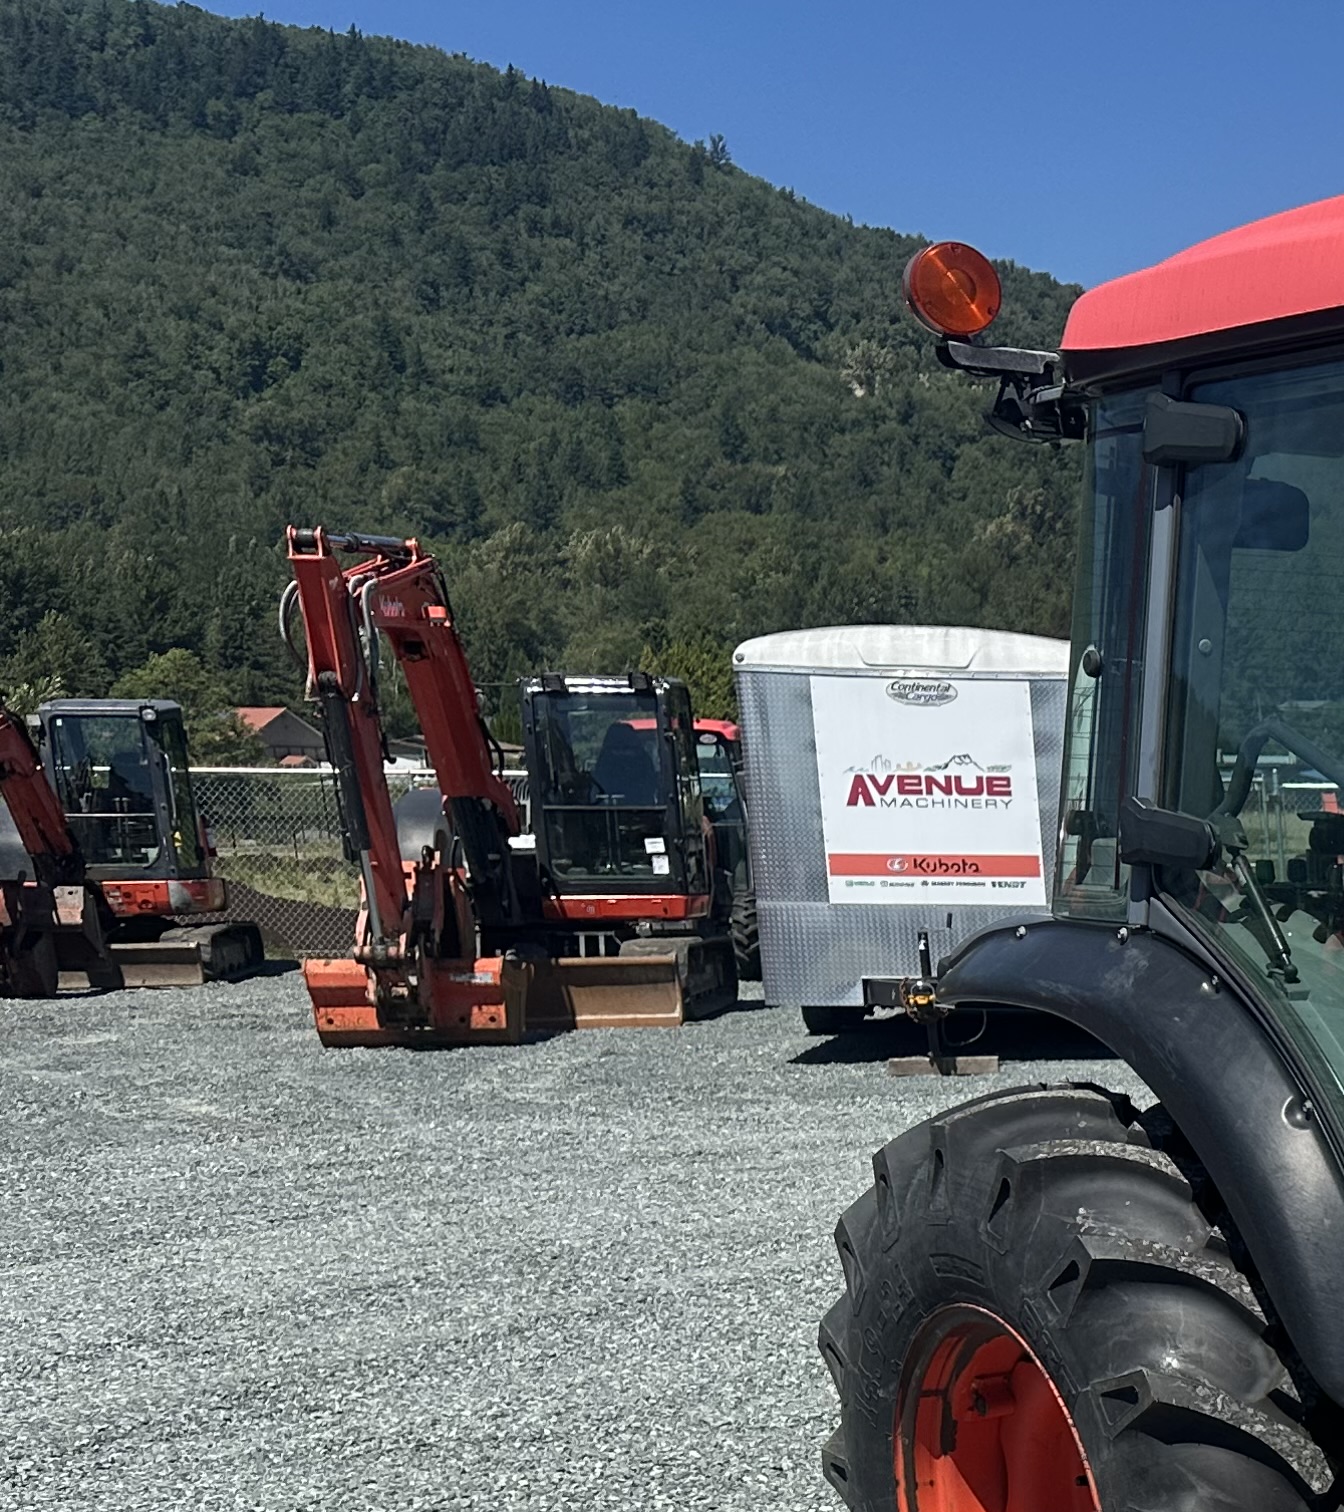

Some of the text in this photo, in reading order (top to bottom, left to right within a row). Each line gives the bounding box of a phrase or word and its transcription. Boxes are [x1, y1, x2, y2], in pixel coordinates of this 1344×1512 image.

[891, 681, 951, 694] Continental
[846, 774, 1012, 807] AVENUE
[880, 797, 1013, 810] MACHINERY
[912, 857, 980, 873] Kubota
